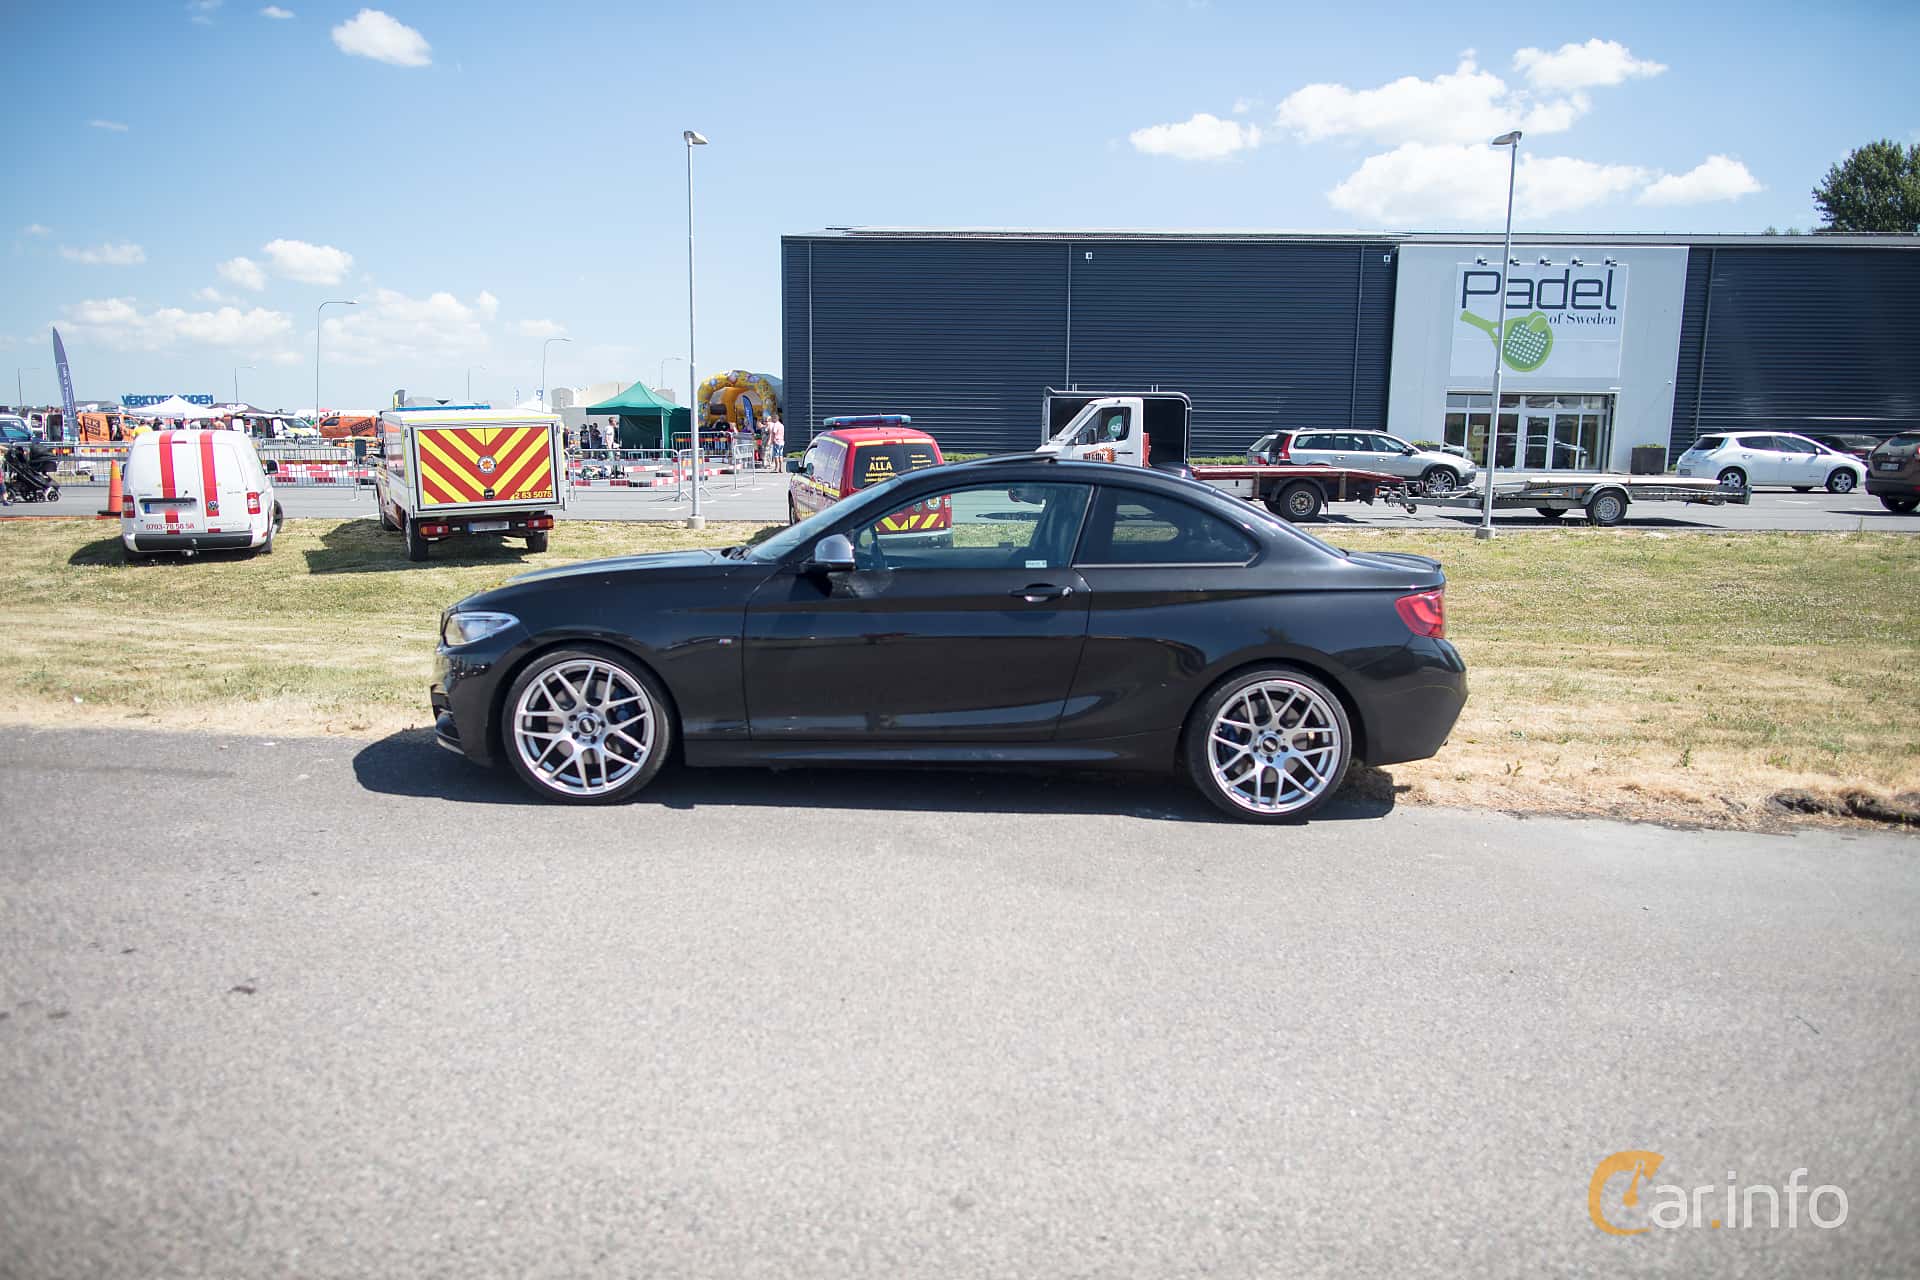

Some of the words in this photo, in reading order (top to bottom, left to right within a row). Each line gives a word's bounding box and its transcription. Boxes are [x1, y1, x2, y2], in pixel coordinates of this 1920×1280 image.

[1461, 268, 1617, 310] Padel
[1549, 312, 1562, 325] of
[1566, 312, 1617, 325] Sweden
[869, 461, 893, 471] ALLA
